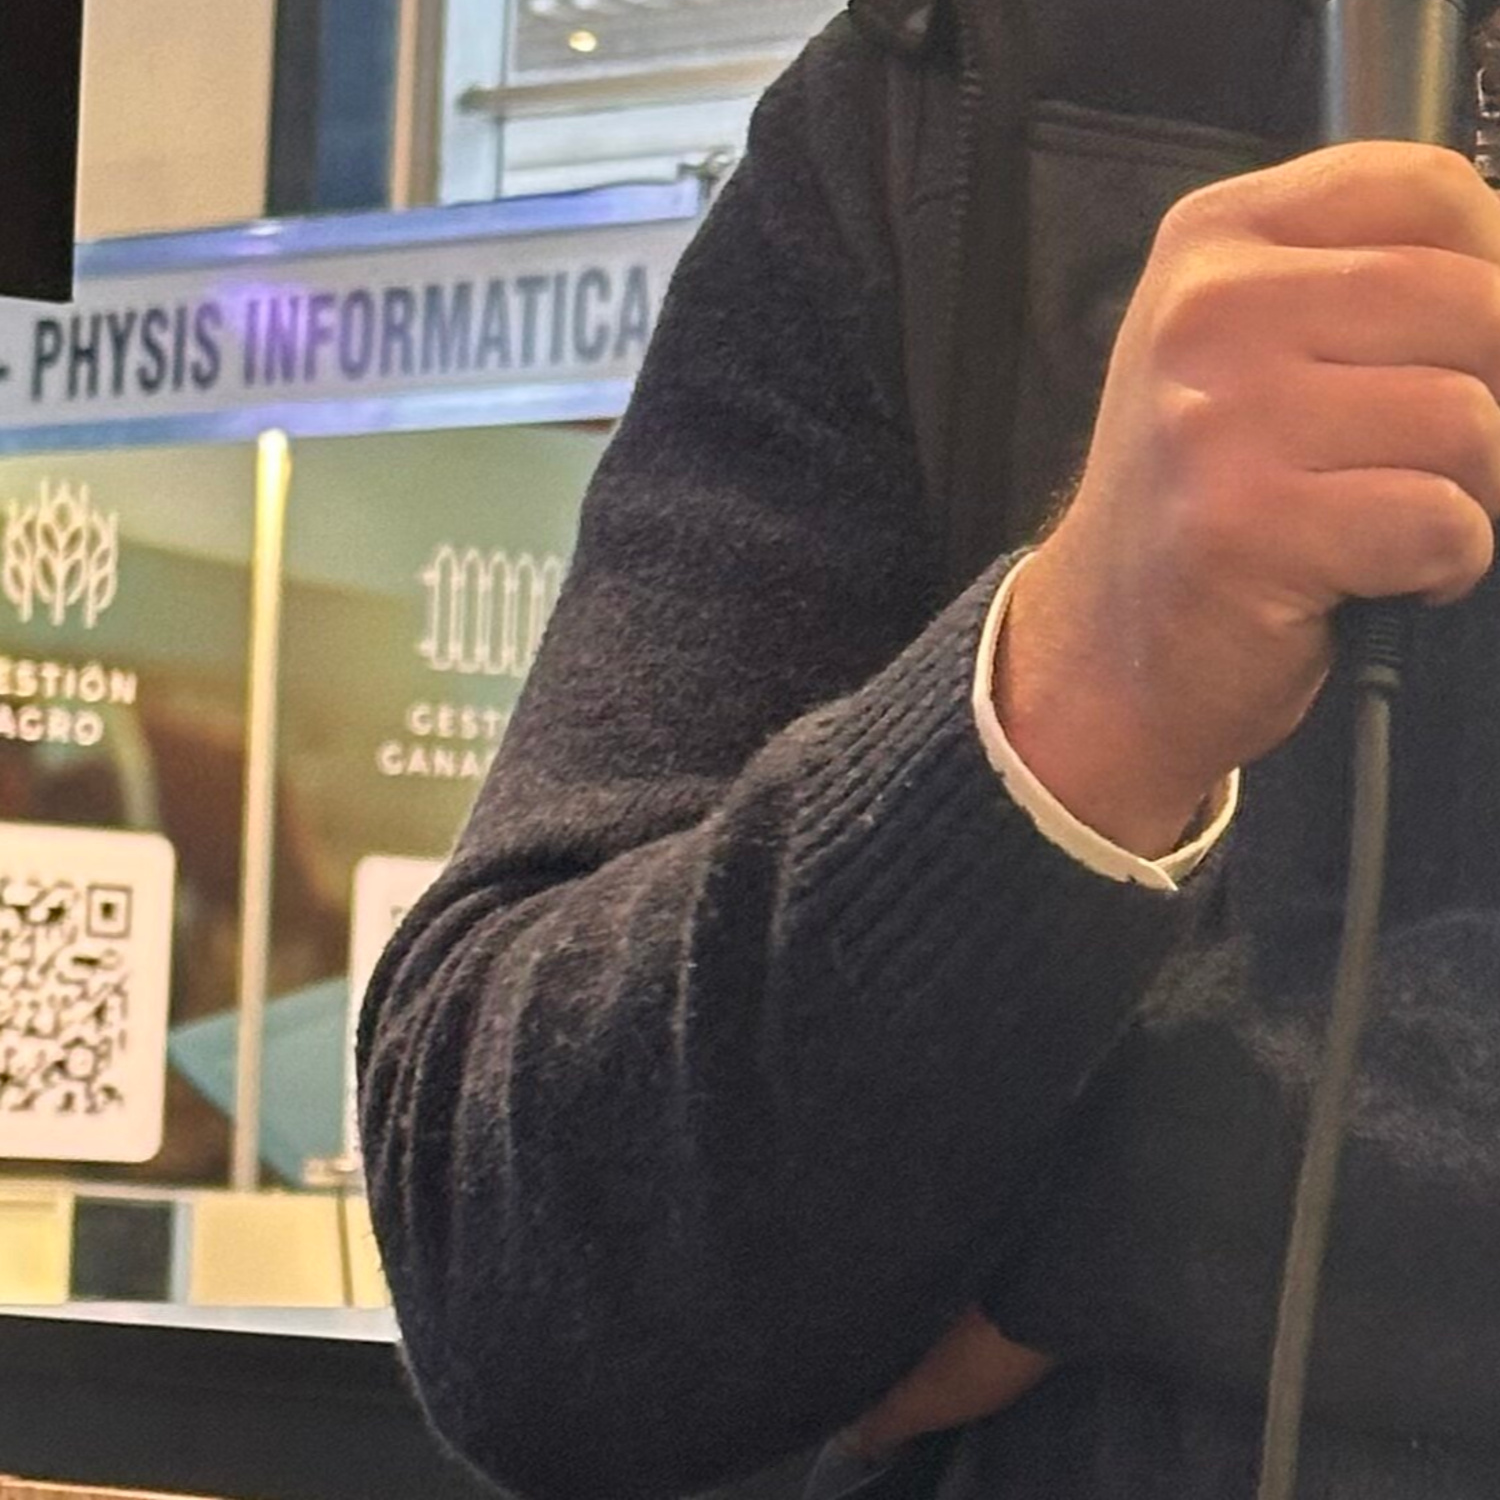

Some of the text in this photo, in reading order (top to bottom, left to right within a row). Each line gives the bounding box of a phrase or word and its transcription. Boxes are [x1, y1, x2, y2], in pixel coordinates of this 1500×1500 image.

[31, 301, 223, 401] PHYSIS
[243, 267, 650, 387] INFORMATICA
[0, 702, 104, 746] AGRO
[377, 741, 493, 779] GANA
